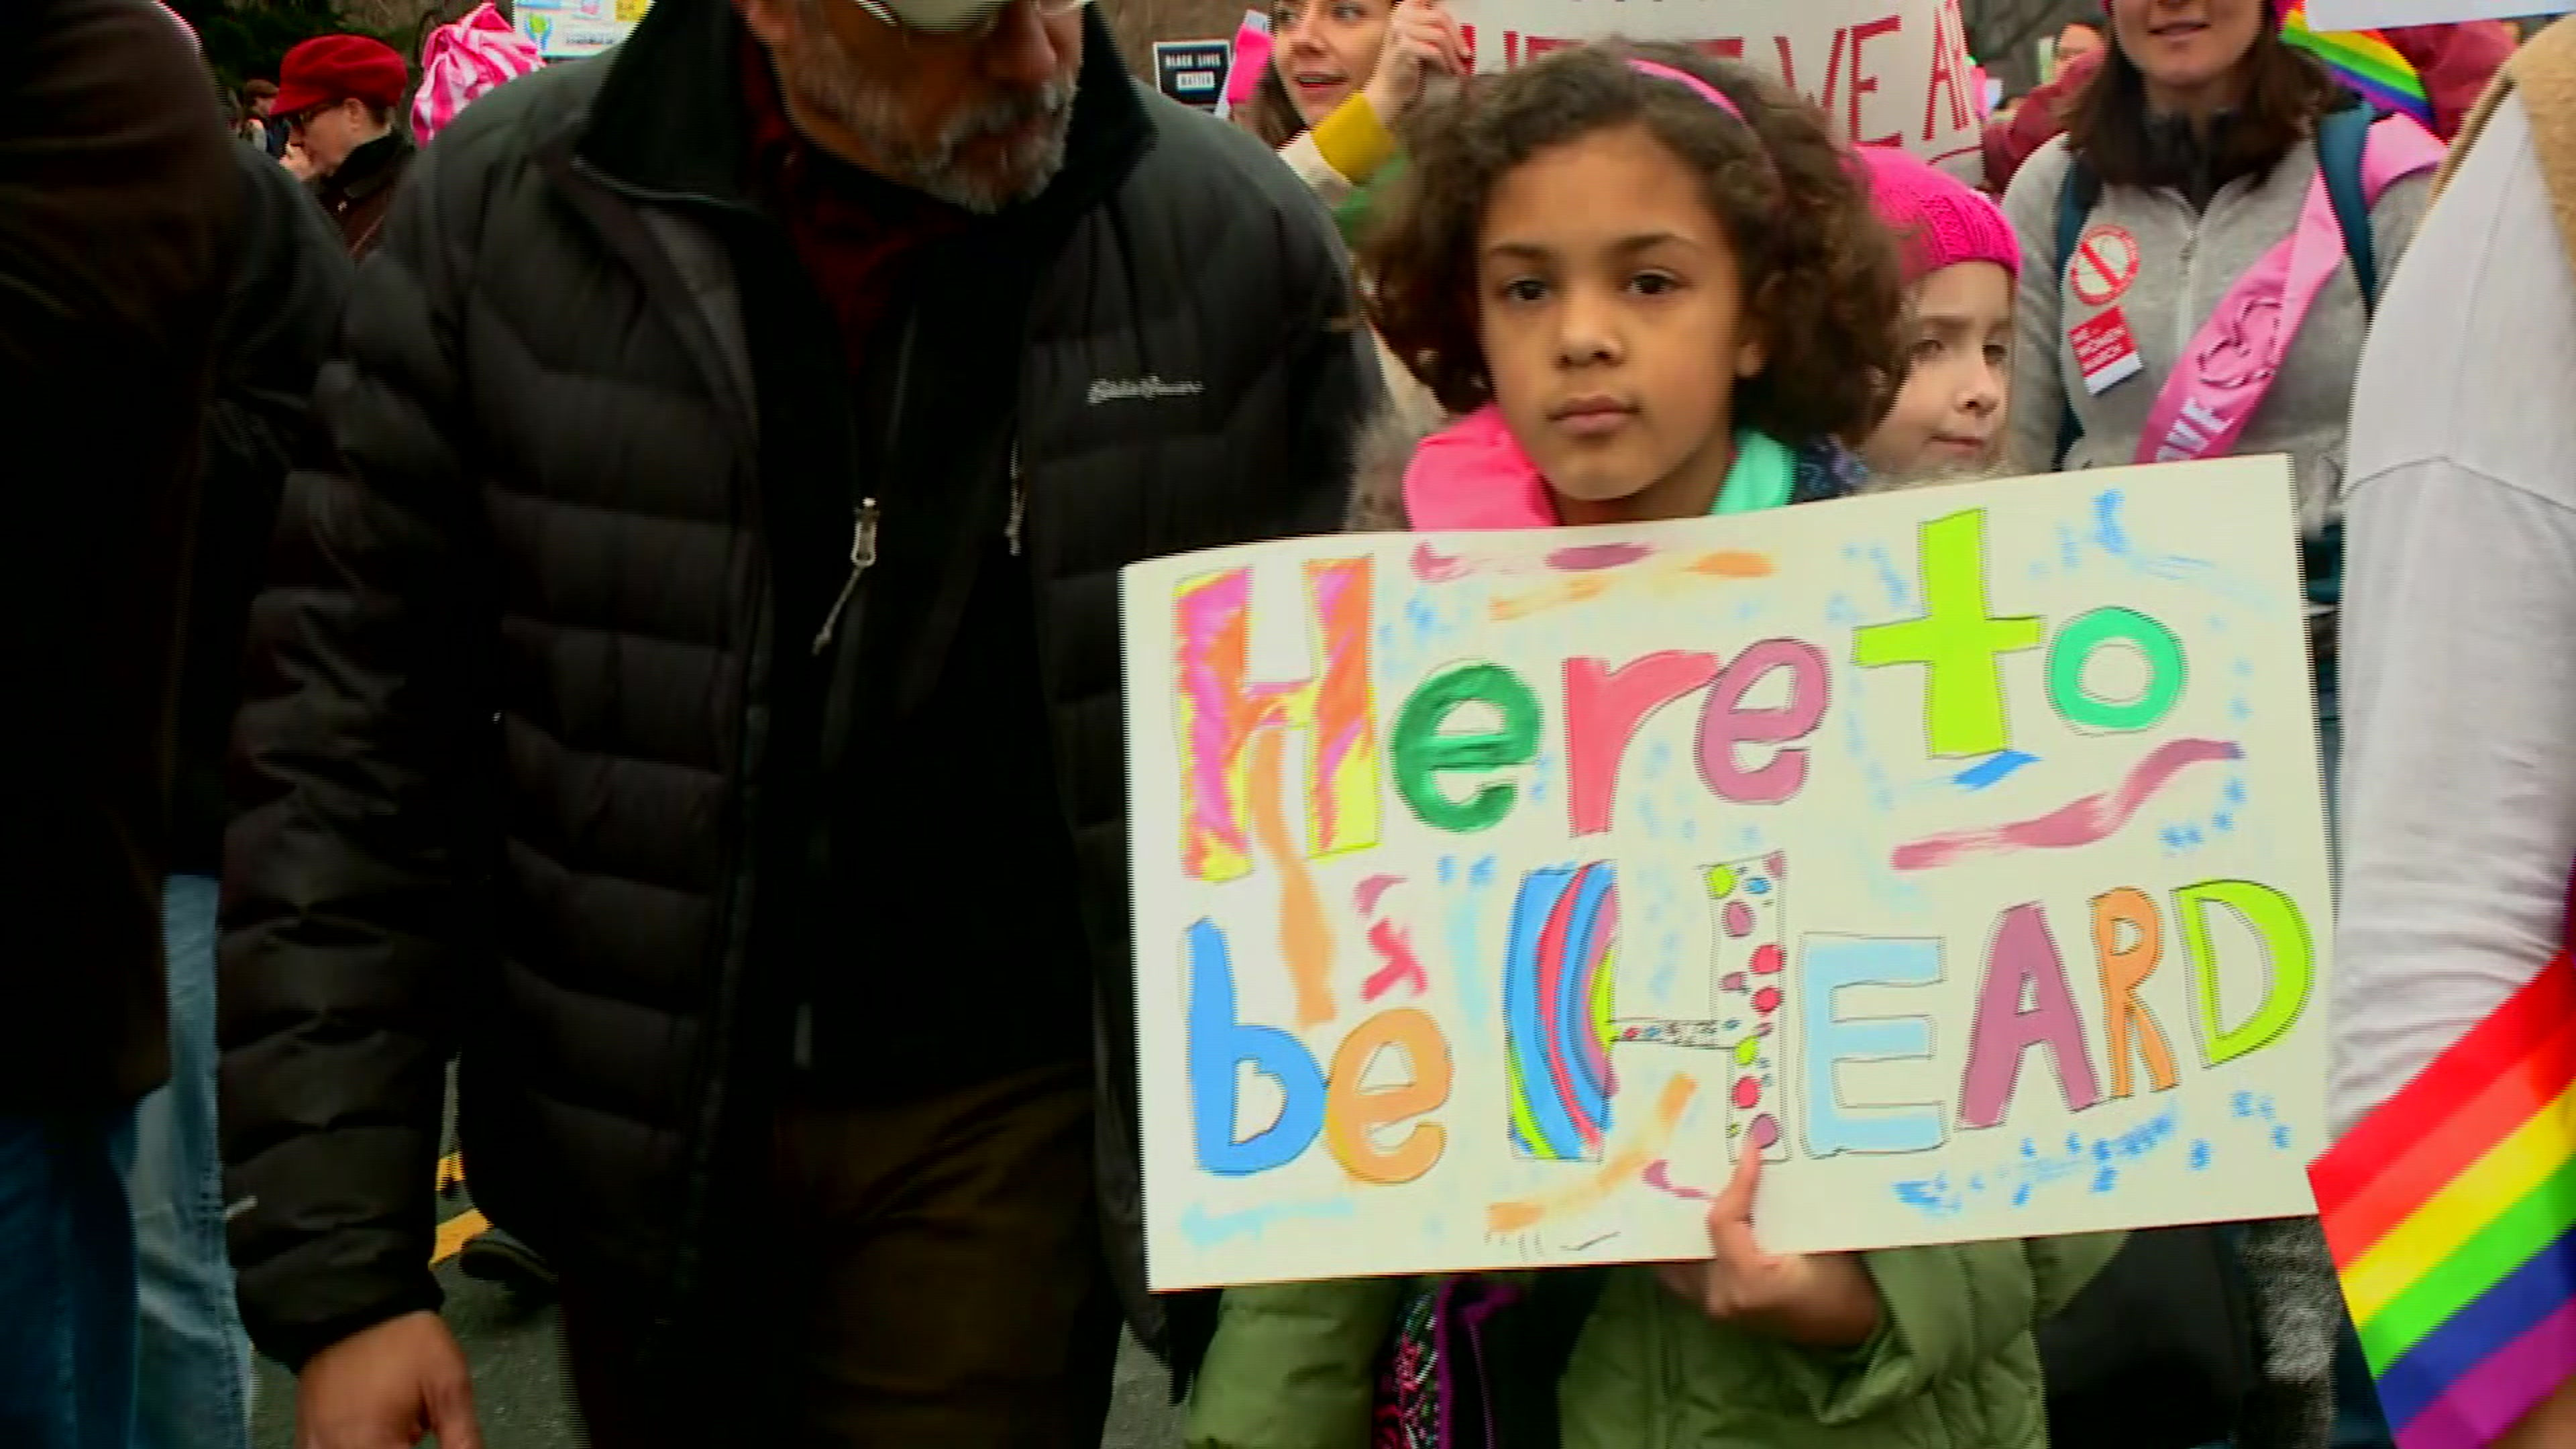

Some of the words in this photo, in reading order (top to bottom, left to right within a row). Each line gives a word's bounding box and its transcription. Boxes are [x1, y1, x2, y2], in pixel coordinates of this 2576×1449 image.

[1165, 54, 1193, 68] BLACK
[1197, 53, 1221, 67] LIVES
[1173, 555, 1831, 882] Here
[1851, 507, 2189, 759] to
[1180, 915, 1454, 1184] be
[1502, 851, 2317, 1165] HEARD
